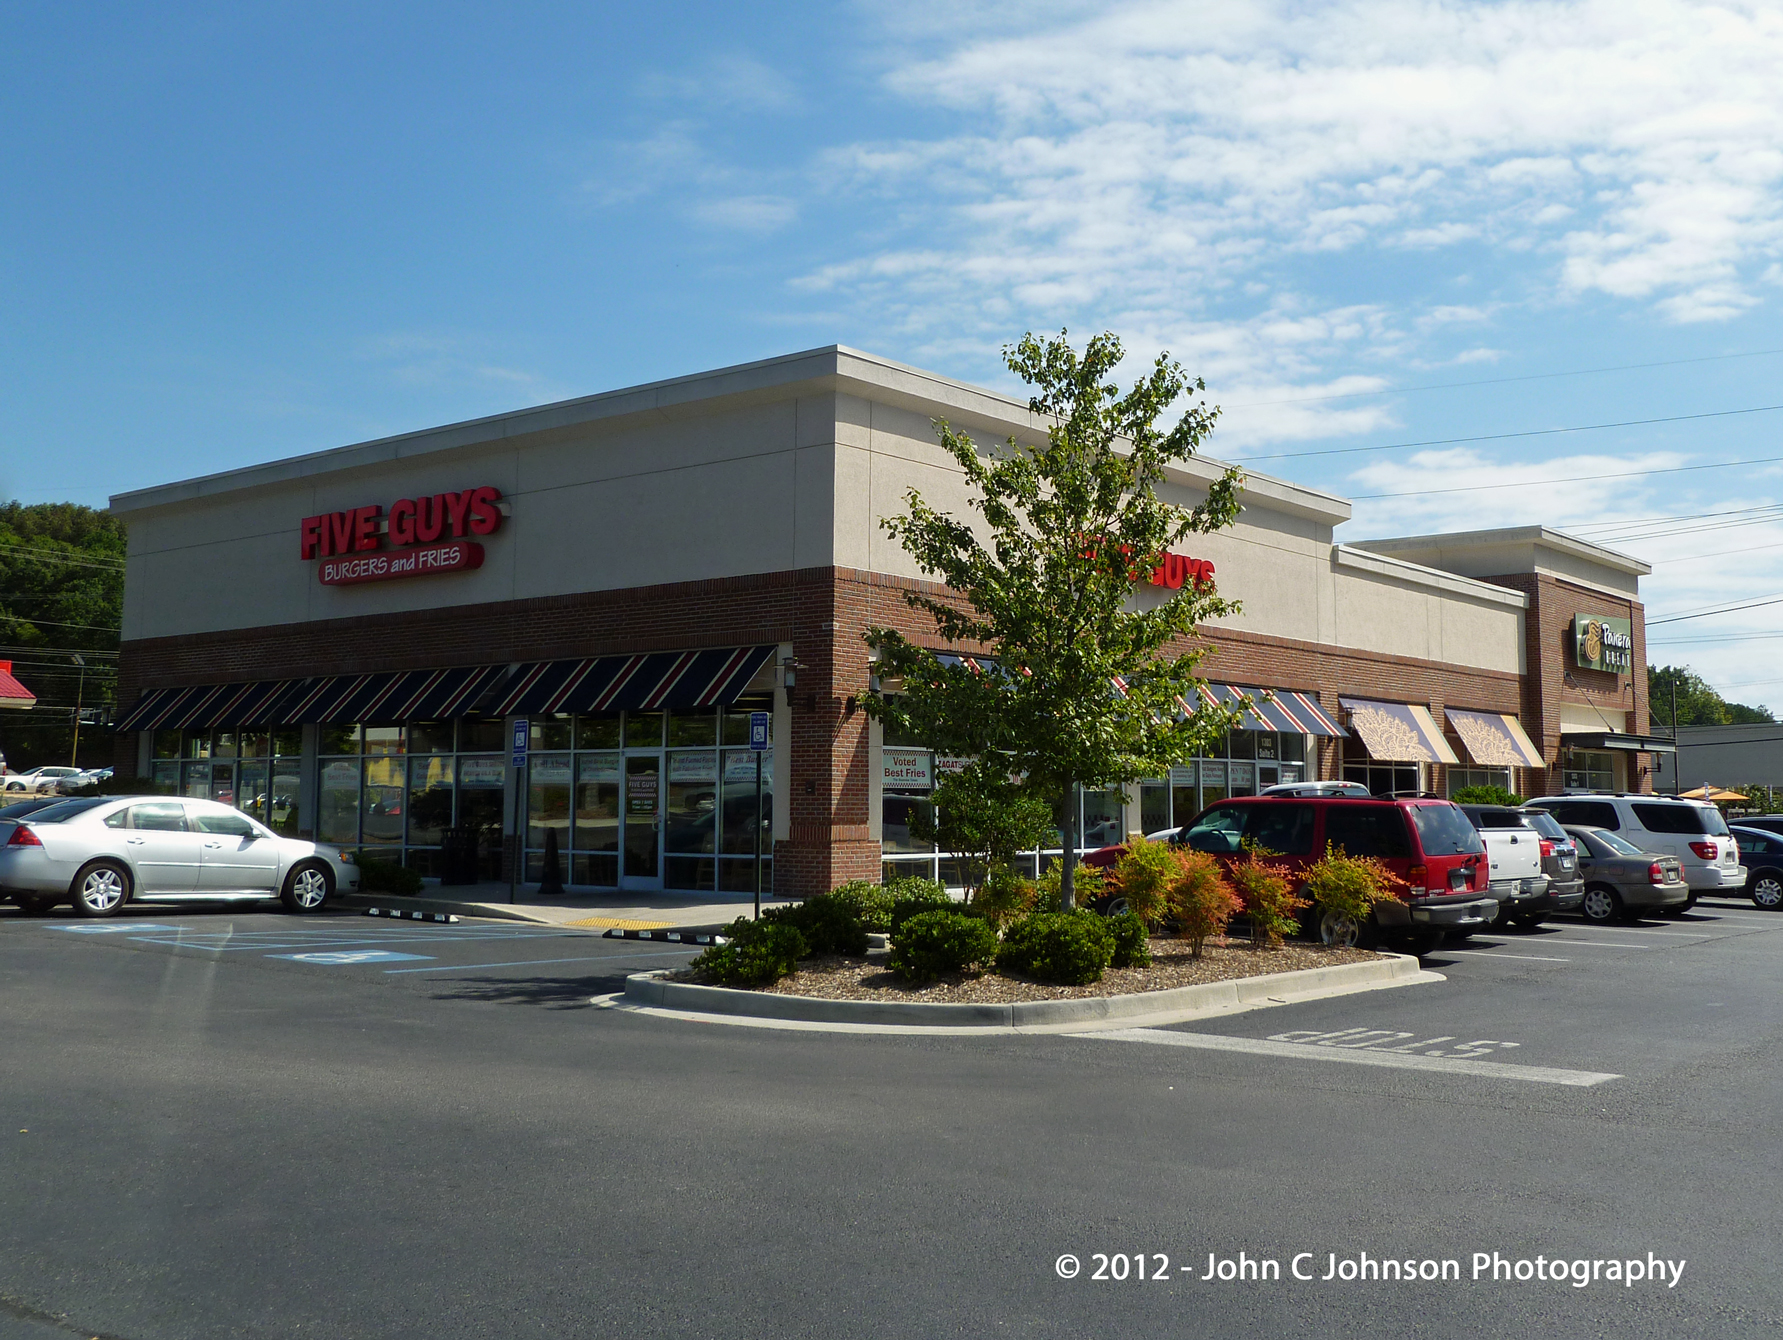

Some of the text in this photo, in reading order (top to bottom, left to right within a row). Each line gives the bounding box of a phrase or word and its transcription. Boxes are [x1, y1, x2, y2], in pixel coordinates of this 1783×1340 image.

[301, 486, 503, 560] FIVE GUYS
[324, 546, 461, 581] BURGERS and FRIES
[1602, 623, 1631, 649] Panera
[884, 768, 926, 778] Best Fries
[893, 757, 917, 766] Voted
[1264, 1026, 1521, 1059] STOP
